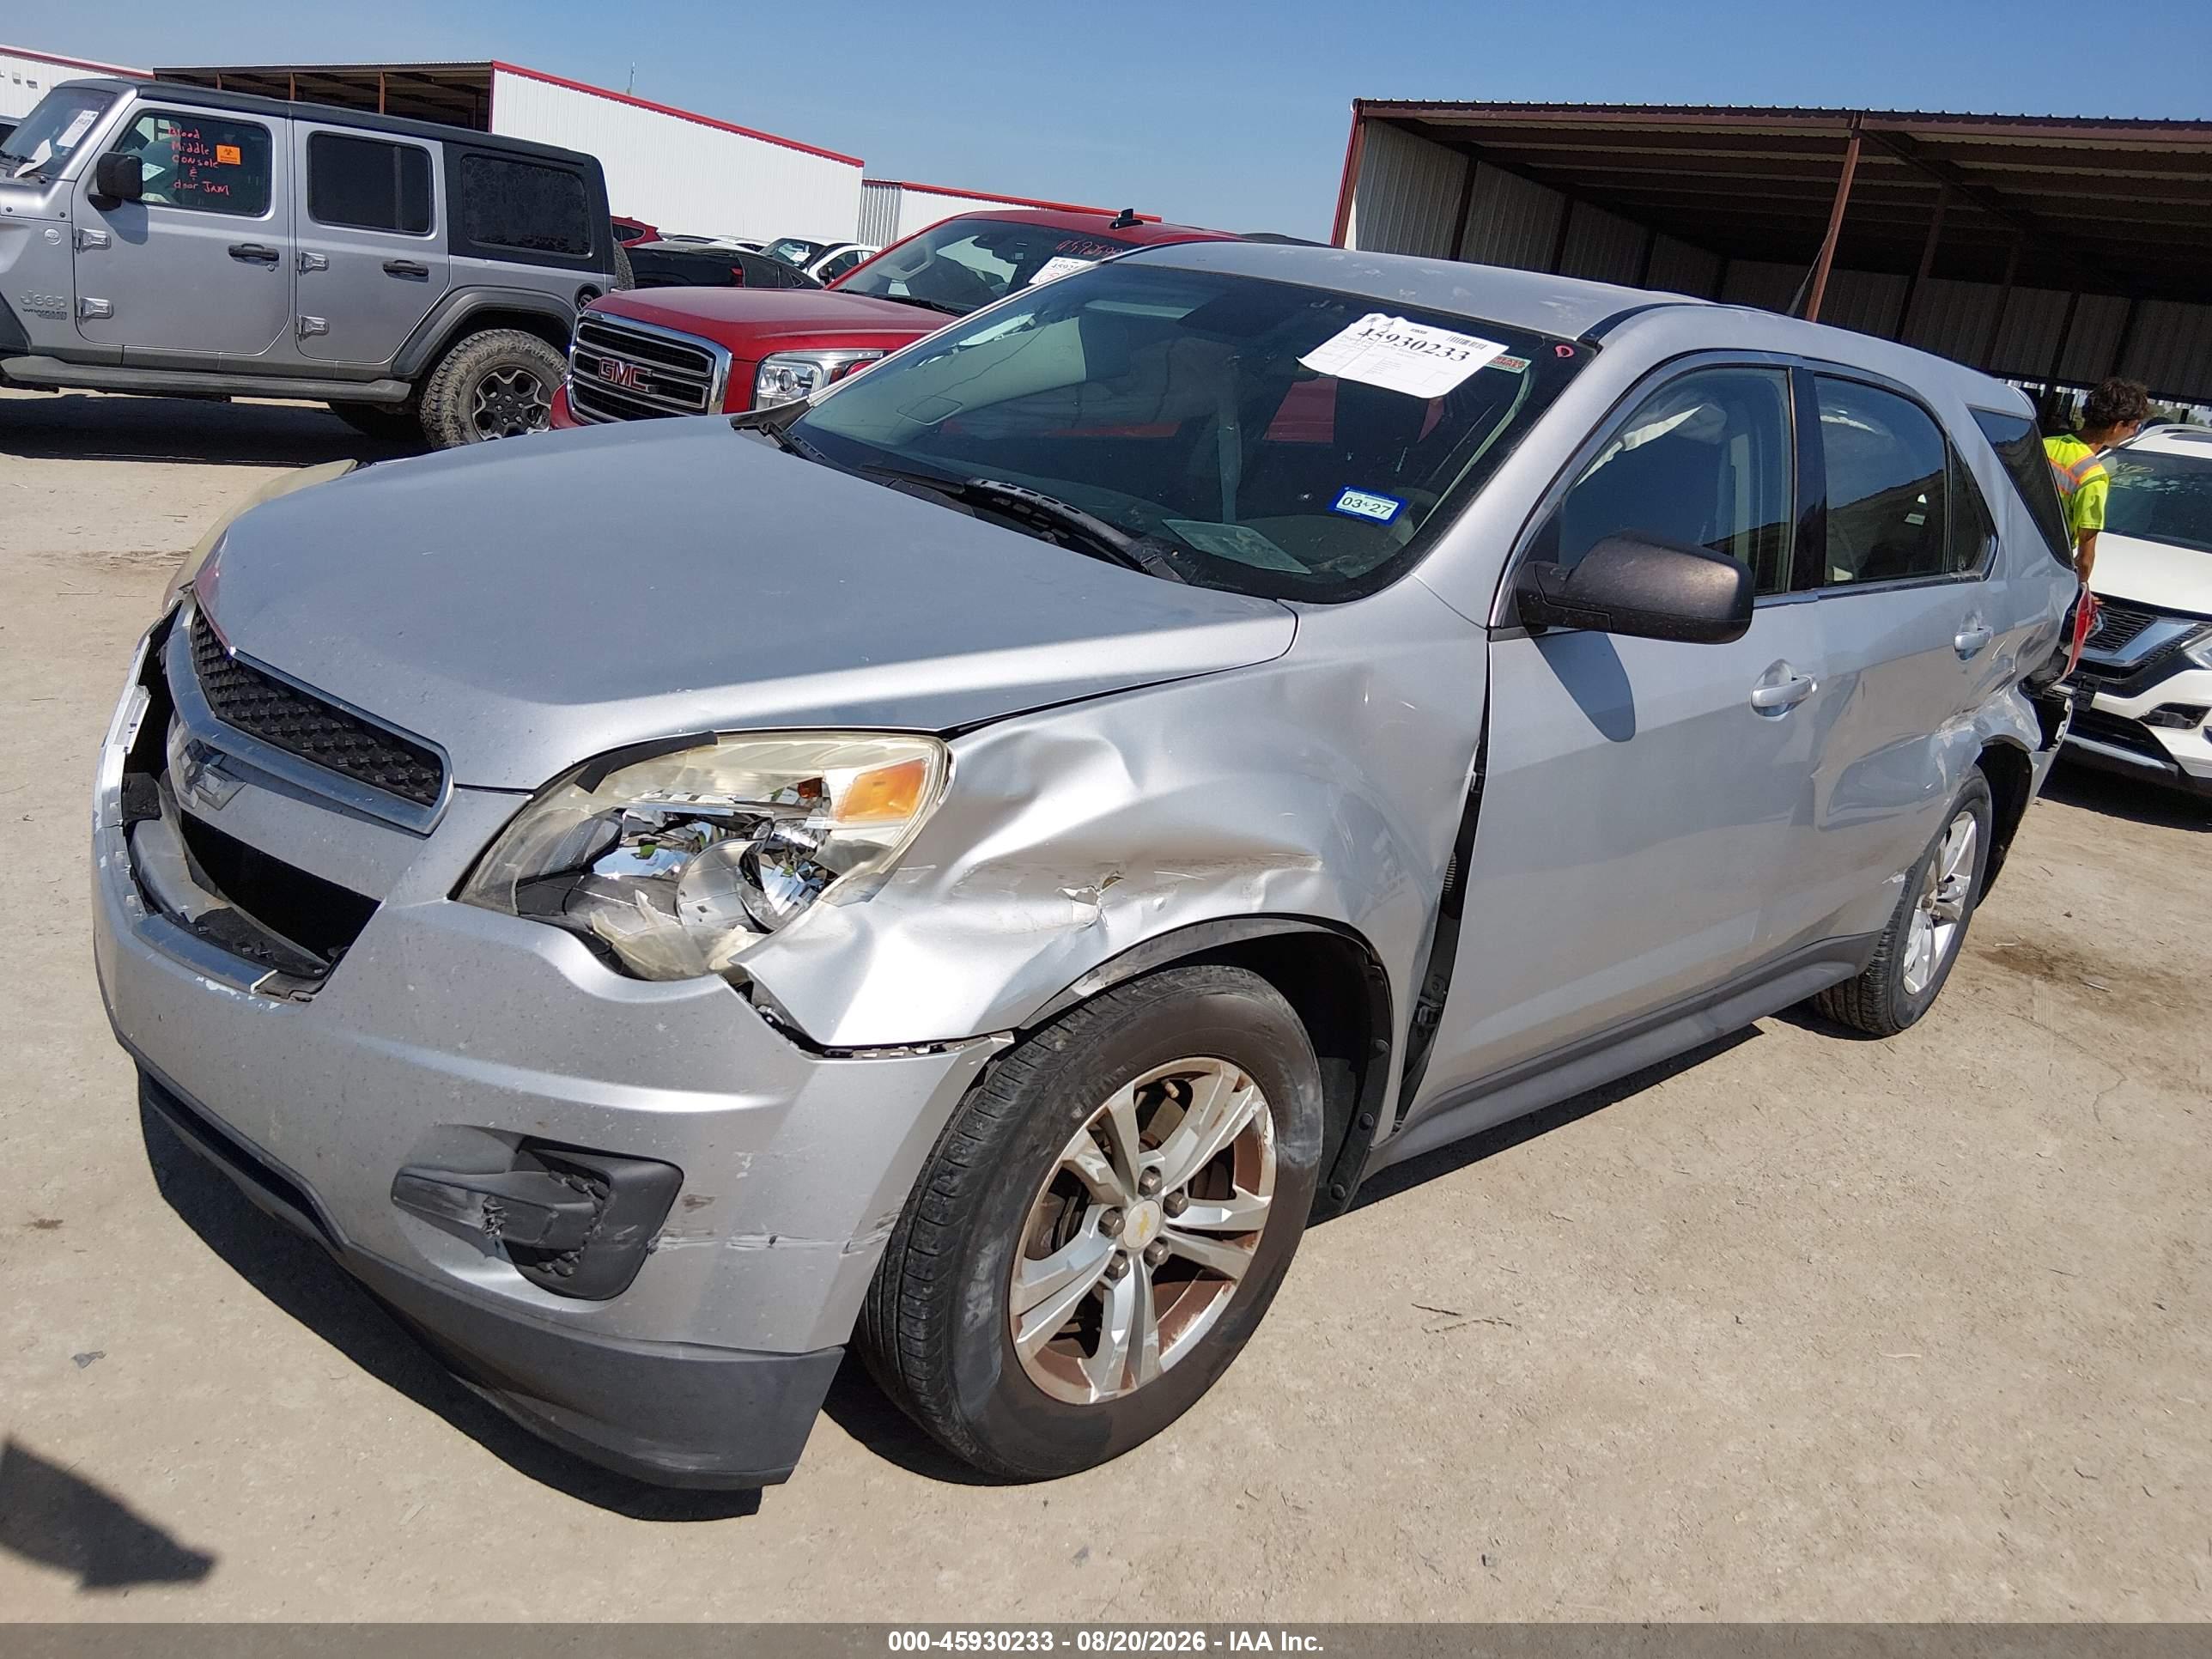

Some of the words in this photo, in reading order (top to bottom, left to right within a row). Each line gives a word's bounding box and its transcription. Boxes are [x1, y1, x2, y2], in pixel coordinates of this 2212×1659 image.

[168, 127, 200, 139] Blood
[171, 141, 210, 155] Middle
[21, 289, 67, 310] Jeep
[1358, 327, 1470, 362] 45930233
[599, 356, 653, 392] GMC
[1341, 496, 1363, 508] 03
[1369, 503, 1393, 514] 27
